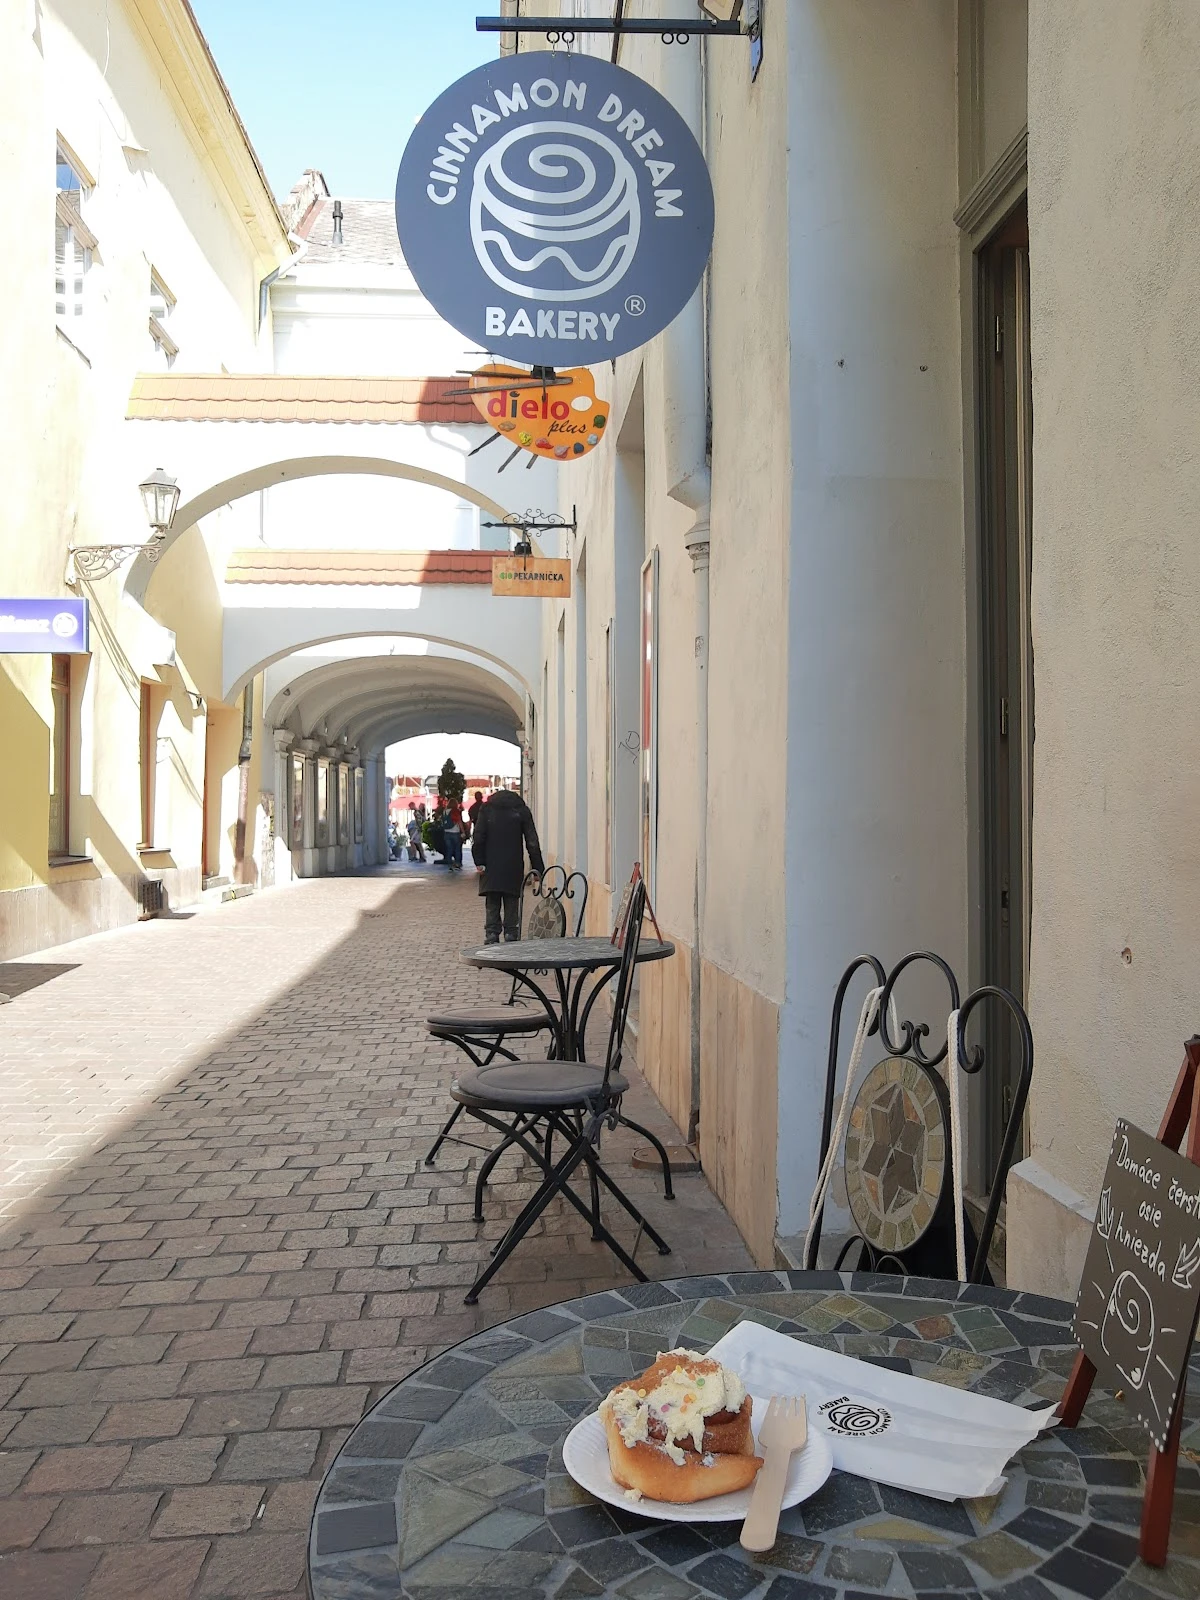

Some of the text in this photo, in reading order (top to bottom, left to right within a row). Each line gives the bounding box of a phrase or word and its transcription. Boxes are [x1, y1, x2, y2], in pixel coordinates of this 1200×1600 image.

[427, 78, 684, 218] CINNAMON DREAM
[485, 306, 621, 341] BAKERY
[487, 390, 570, 420] dielo
[547, 420, 587, 437] plus
[1116, 1134, 1161, 1190] Domáce
[1138, 1200, 1162, 1228] osie
[1115, 1211, 1167, 1282] hniezda
[818, 1396, 850, 1411] BAKERY
